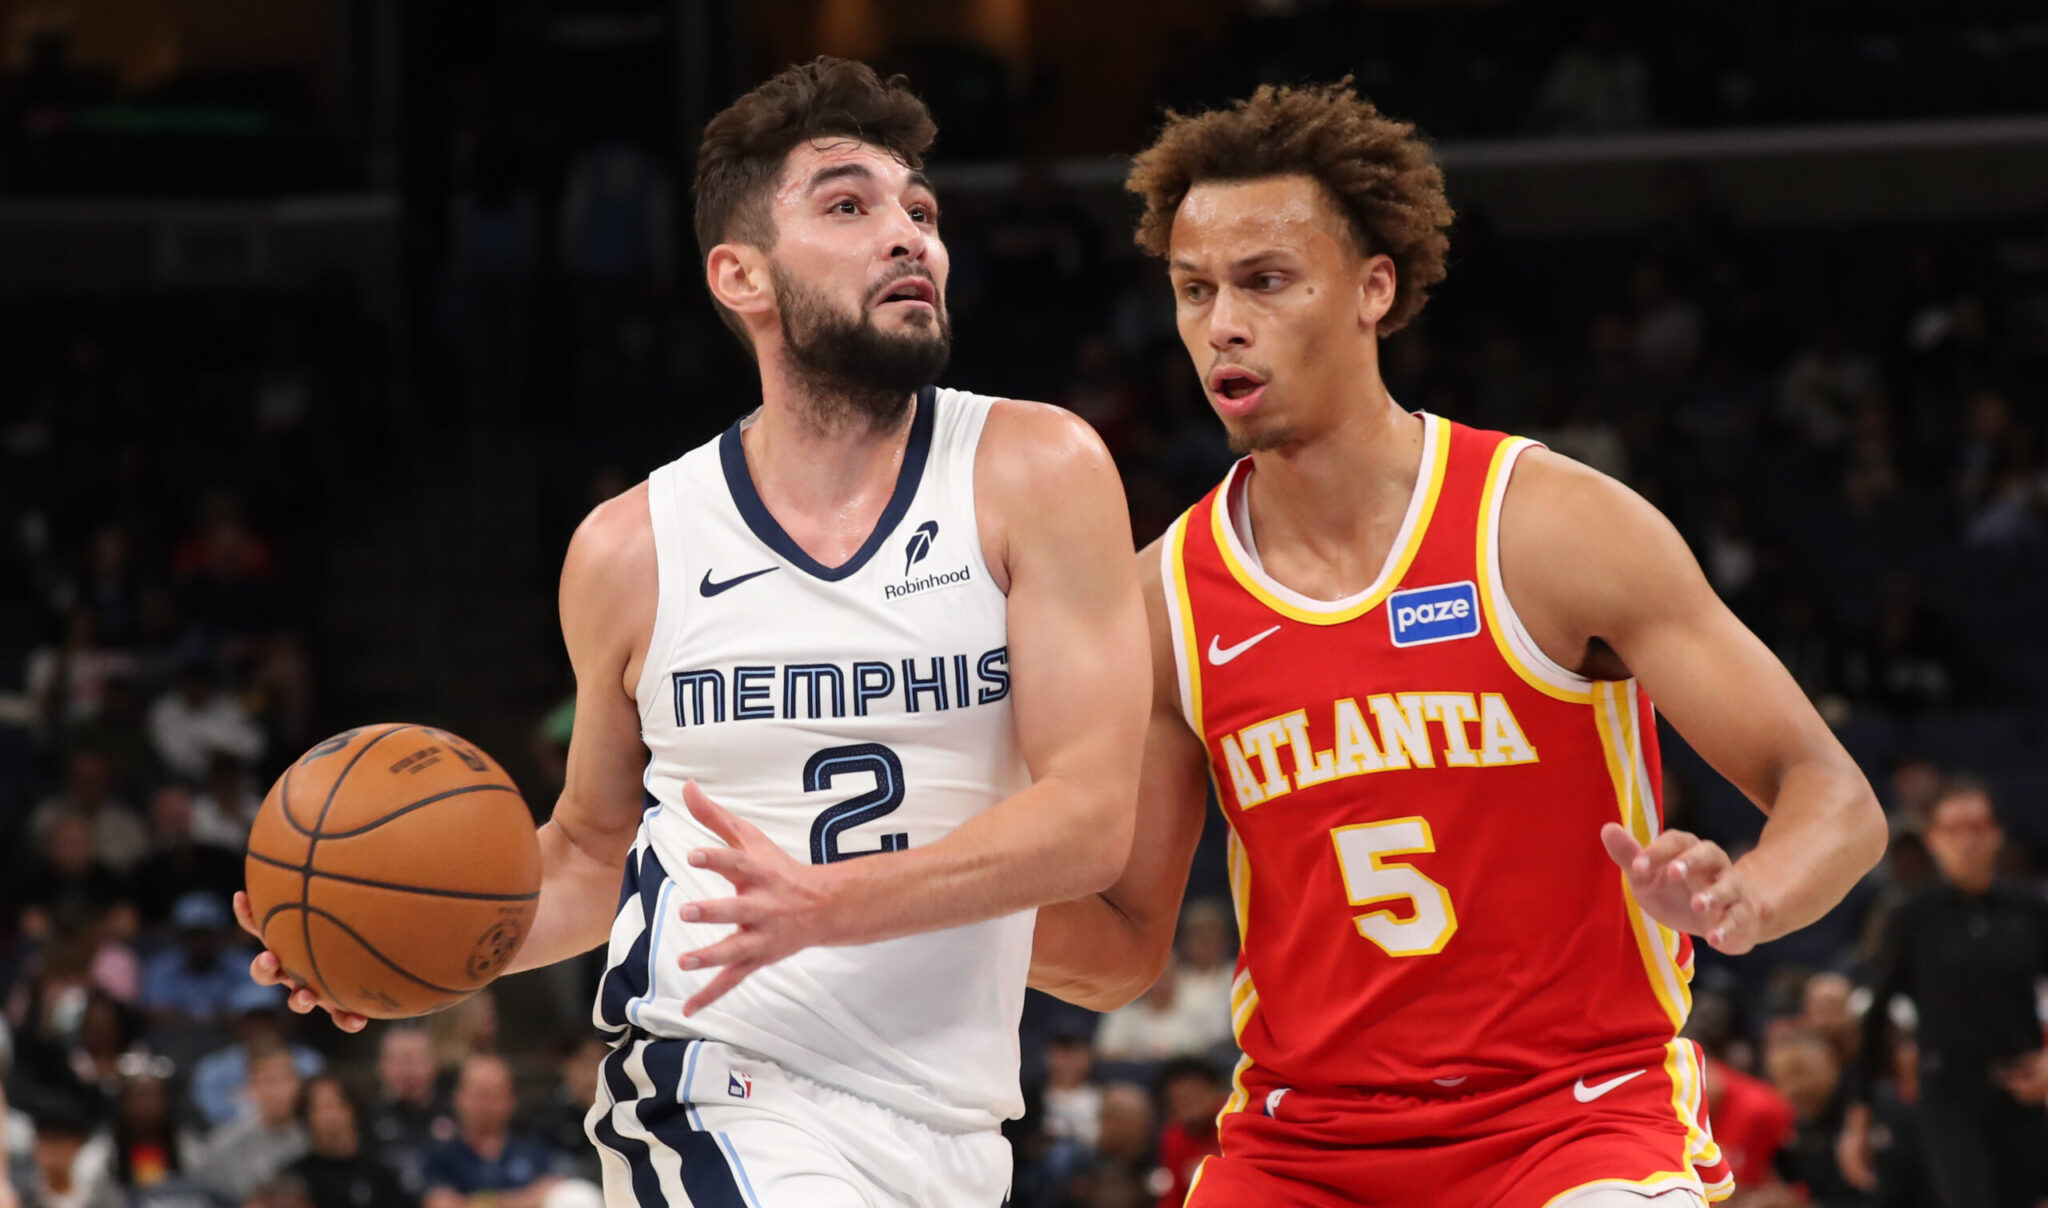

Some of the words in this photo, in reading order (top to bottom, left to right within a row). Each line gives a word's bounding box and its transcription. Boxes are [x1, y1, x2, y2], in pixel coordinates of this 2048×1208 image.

[884, 565, 971, 600] Robinhood
[1397, 598, 1470, 633] paze
[672, 645, 1010, 727] MEMPHIS
[1220, 691, 1540, 811] ATLANTA
[802, 742, 909, 865] 2
[1330, 815, 1458, 957] 5
